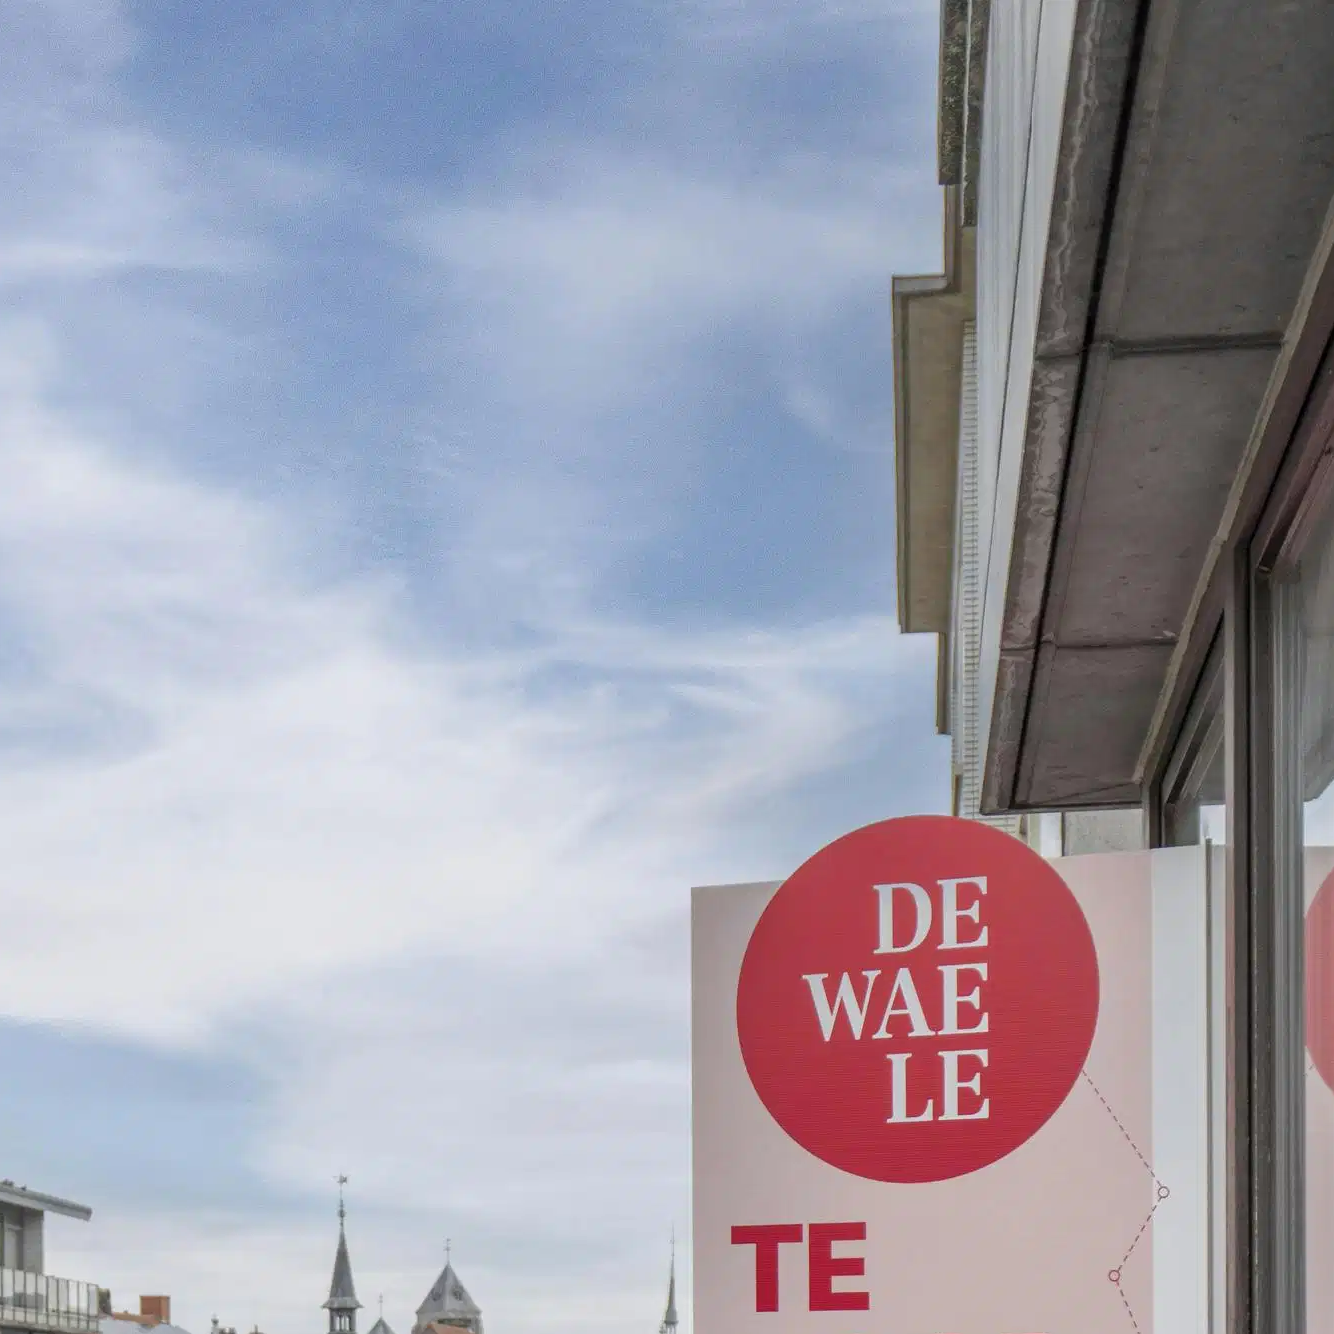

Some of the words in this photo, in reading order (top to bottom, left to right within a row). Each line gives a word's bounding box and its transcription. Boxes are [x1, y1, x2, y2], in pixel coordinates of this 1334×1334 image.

[873, 875, 989, 954] DE
[801, 962, 990, 1042] WAE
[886, 1048, 990, 1124] LE
[730, 1221, 871, 1313] TE
